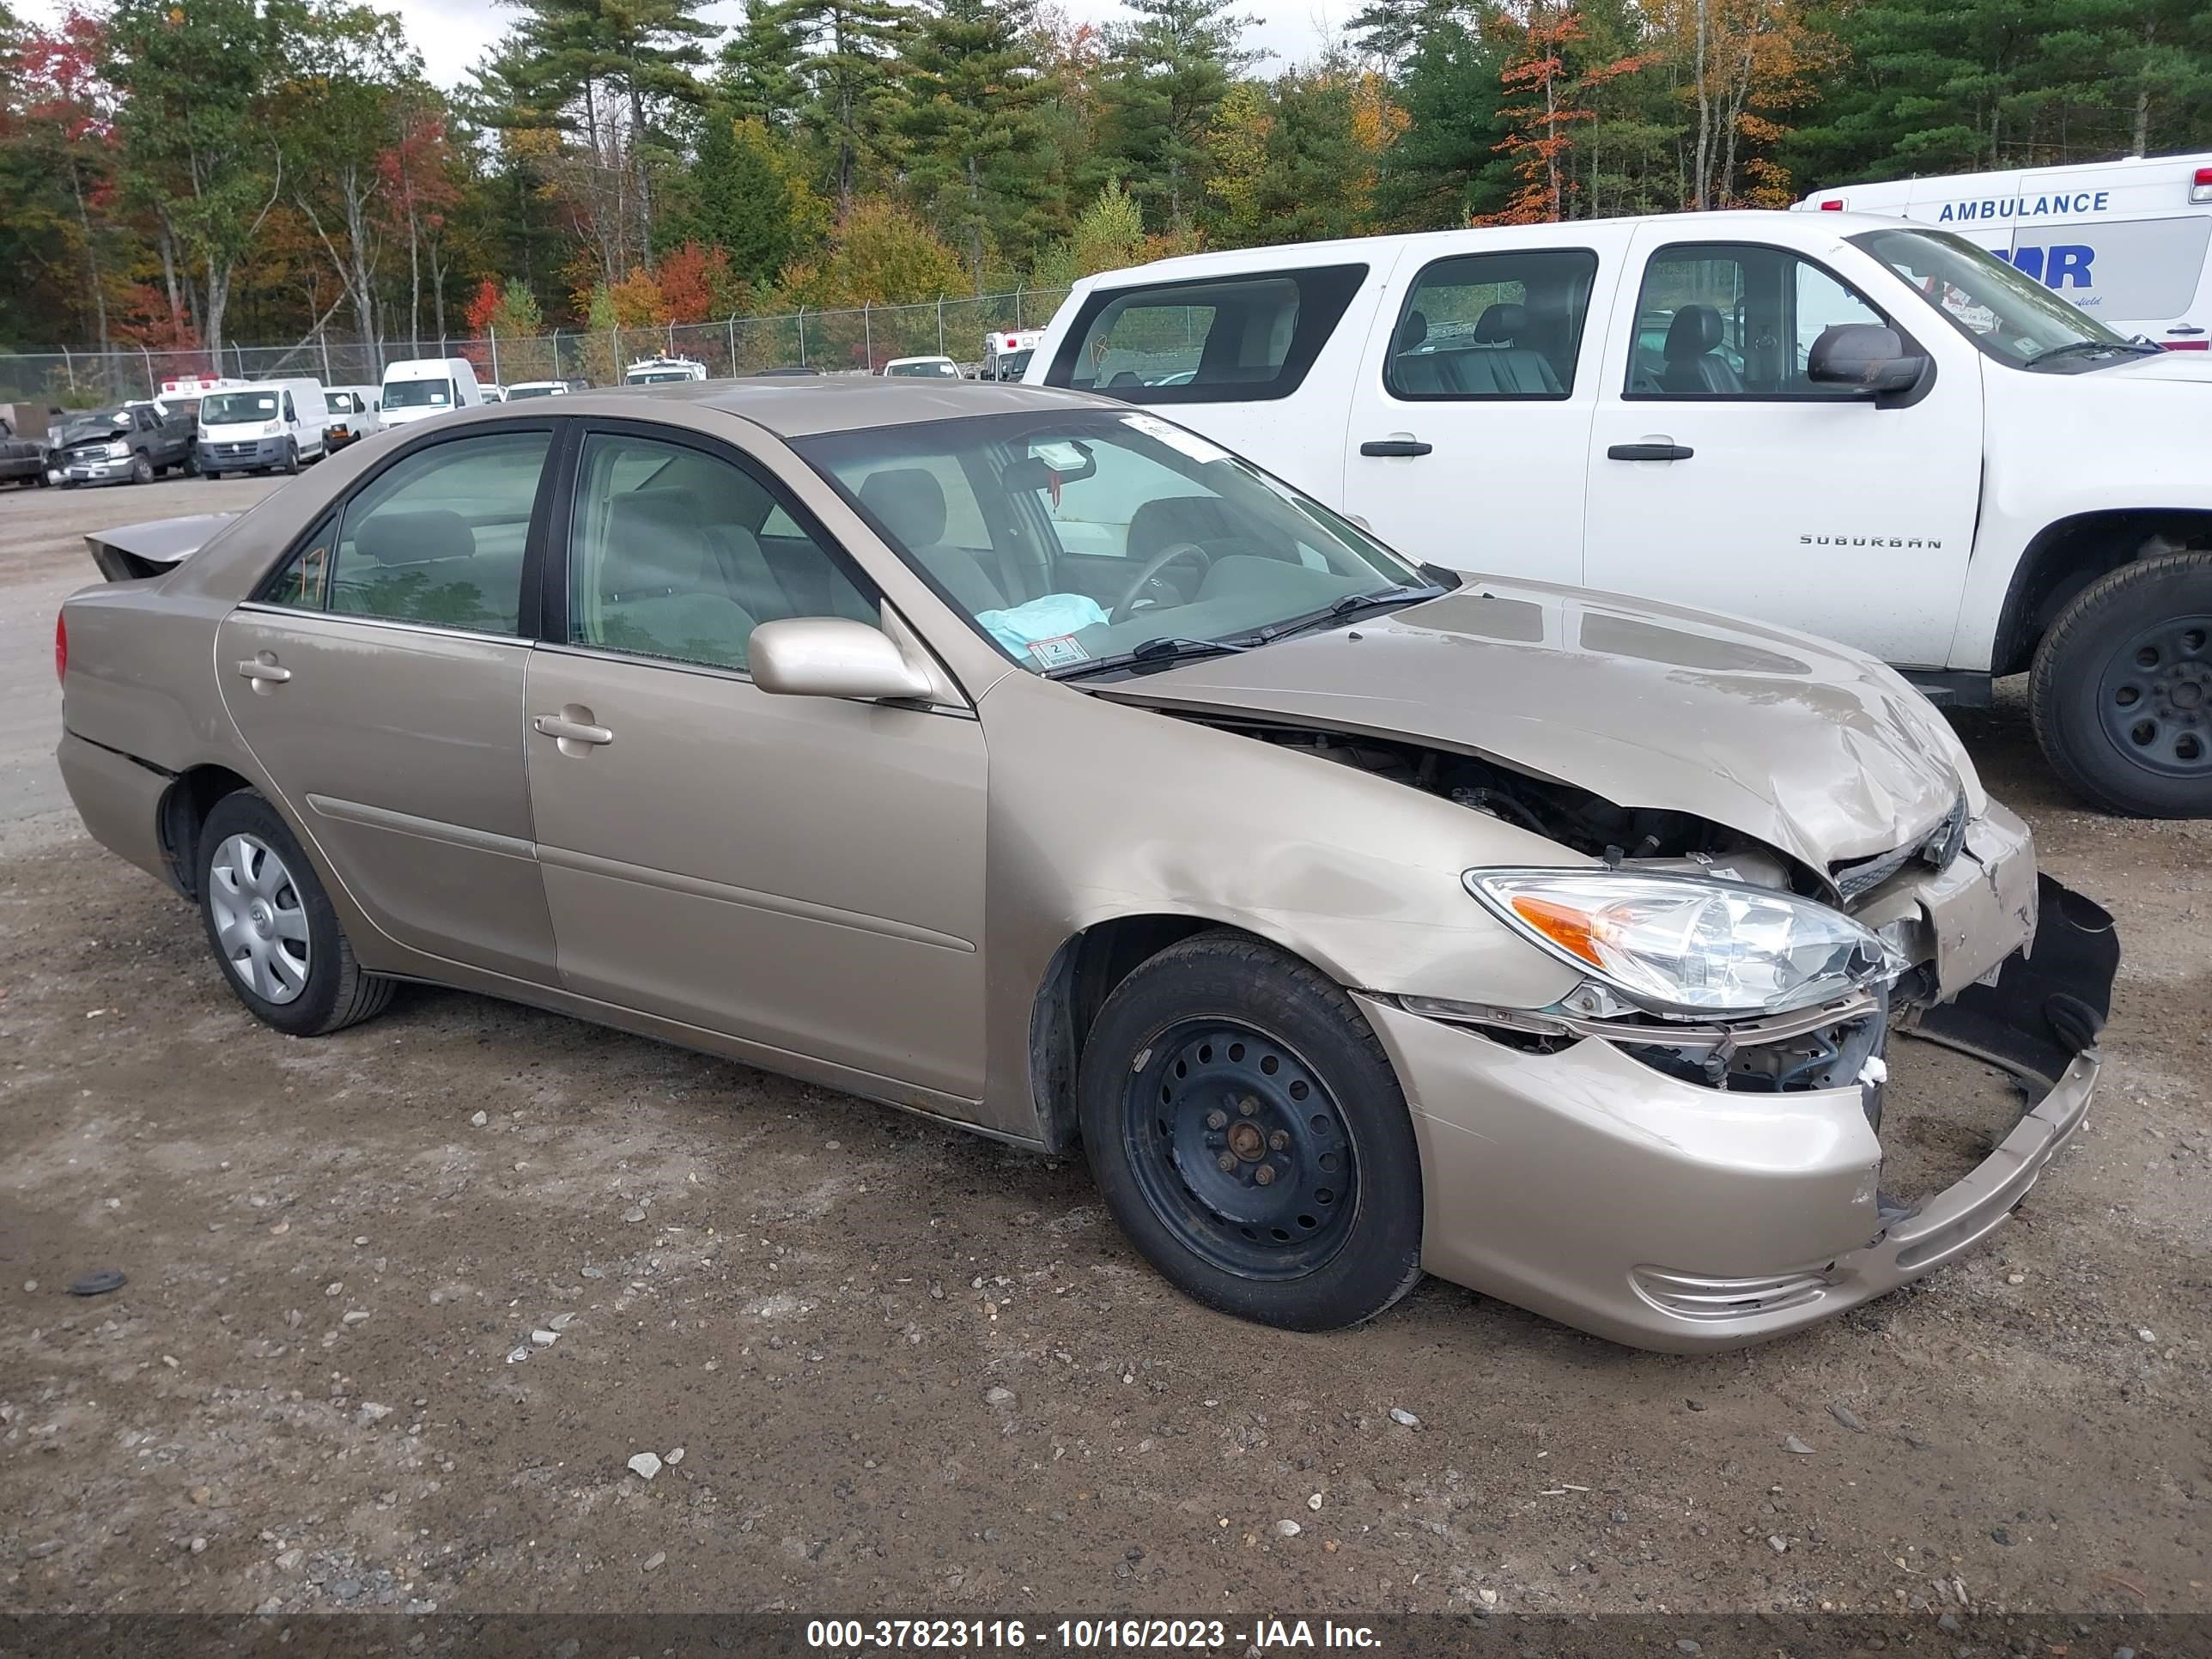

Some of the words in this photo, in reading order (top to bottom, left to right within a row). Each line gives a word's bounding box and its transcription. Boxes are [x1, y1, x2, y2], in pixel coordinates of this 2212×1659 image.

[1938, 191, 2110, 222] AMBULANCE
[1990, 245, 2095, 289] MR
[1800, 533, 1942, 550] SUBURBAN
[1050, 644, 1062, 653] 2
